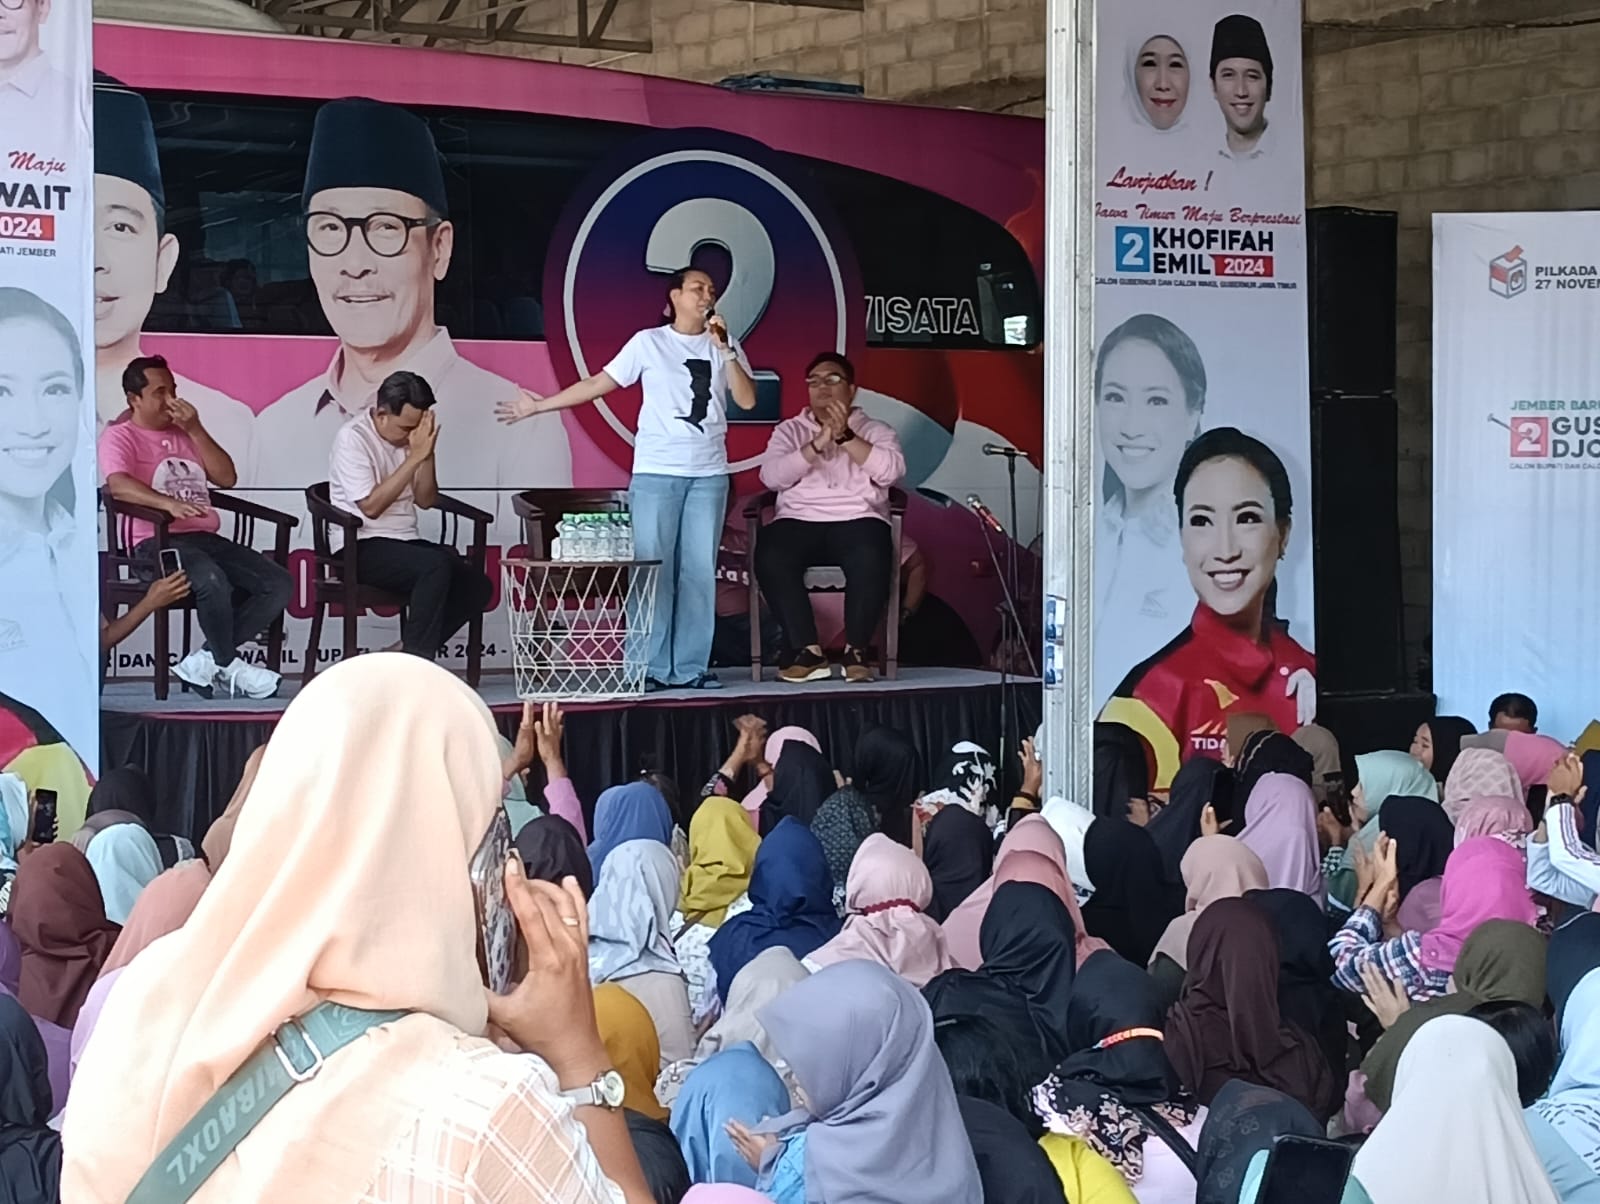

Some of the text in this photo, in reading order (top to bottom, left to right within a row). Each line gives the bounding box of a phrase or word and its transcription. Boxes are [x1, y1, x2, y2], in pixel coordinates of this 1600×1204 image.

[8, 150, 66, 176] Maju
[1106, 166, 1197, 194] Lanjutkan
[0, 182, 71, 210] WAIT
[1135, 203, 1176, 220] Timur
[1182, 205, 1223, 226] Maju
[1229, 207, 1302, 226] Berprestasi
[1122, 232, 1144, 266] 2
[1153, 227, 1273, 252] KHOFIFAH
[17, 248, 56, 257] JEMBER
[1153, 253, 1265, 275] EMIL 2024
[1535, 266, 1597, 276] PILKADA
[1535, 280, 1551, 289] 27
[1511, 400, 1600, 411] JEMBER BAR
[1517, 421, 1542, 452] 2
